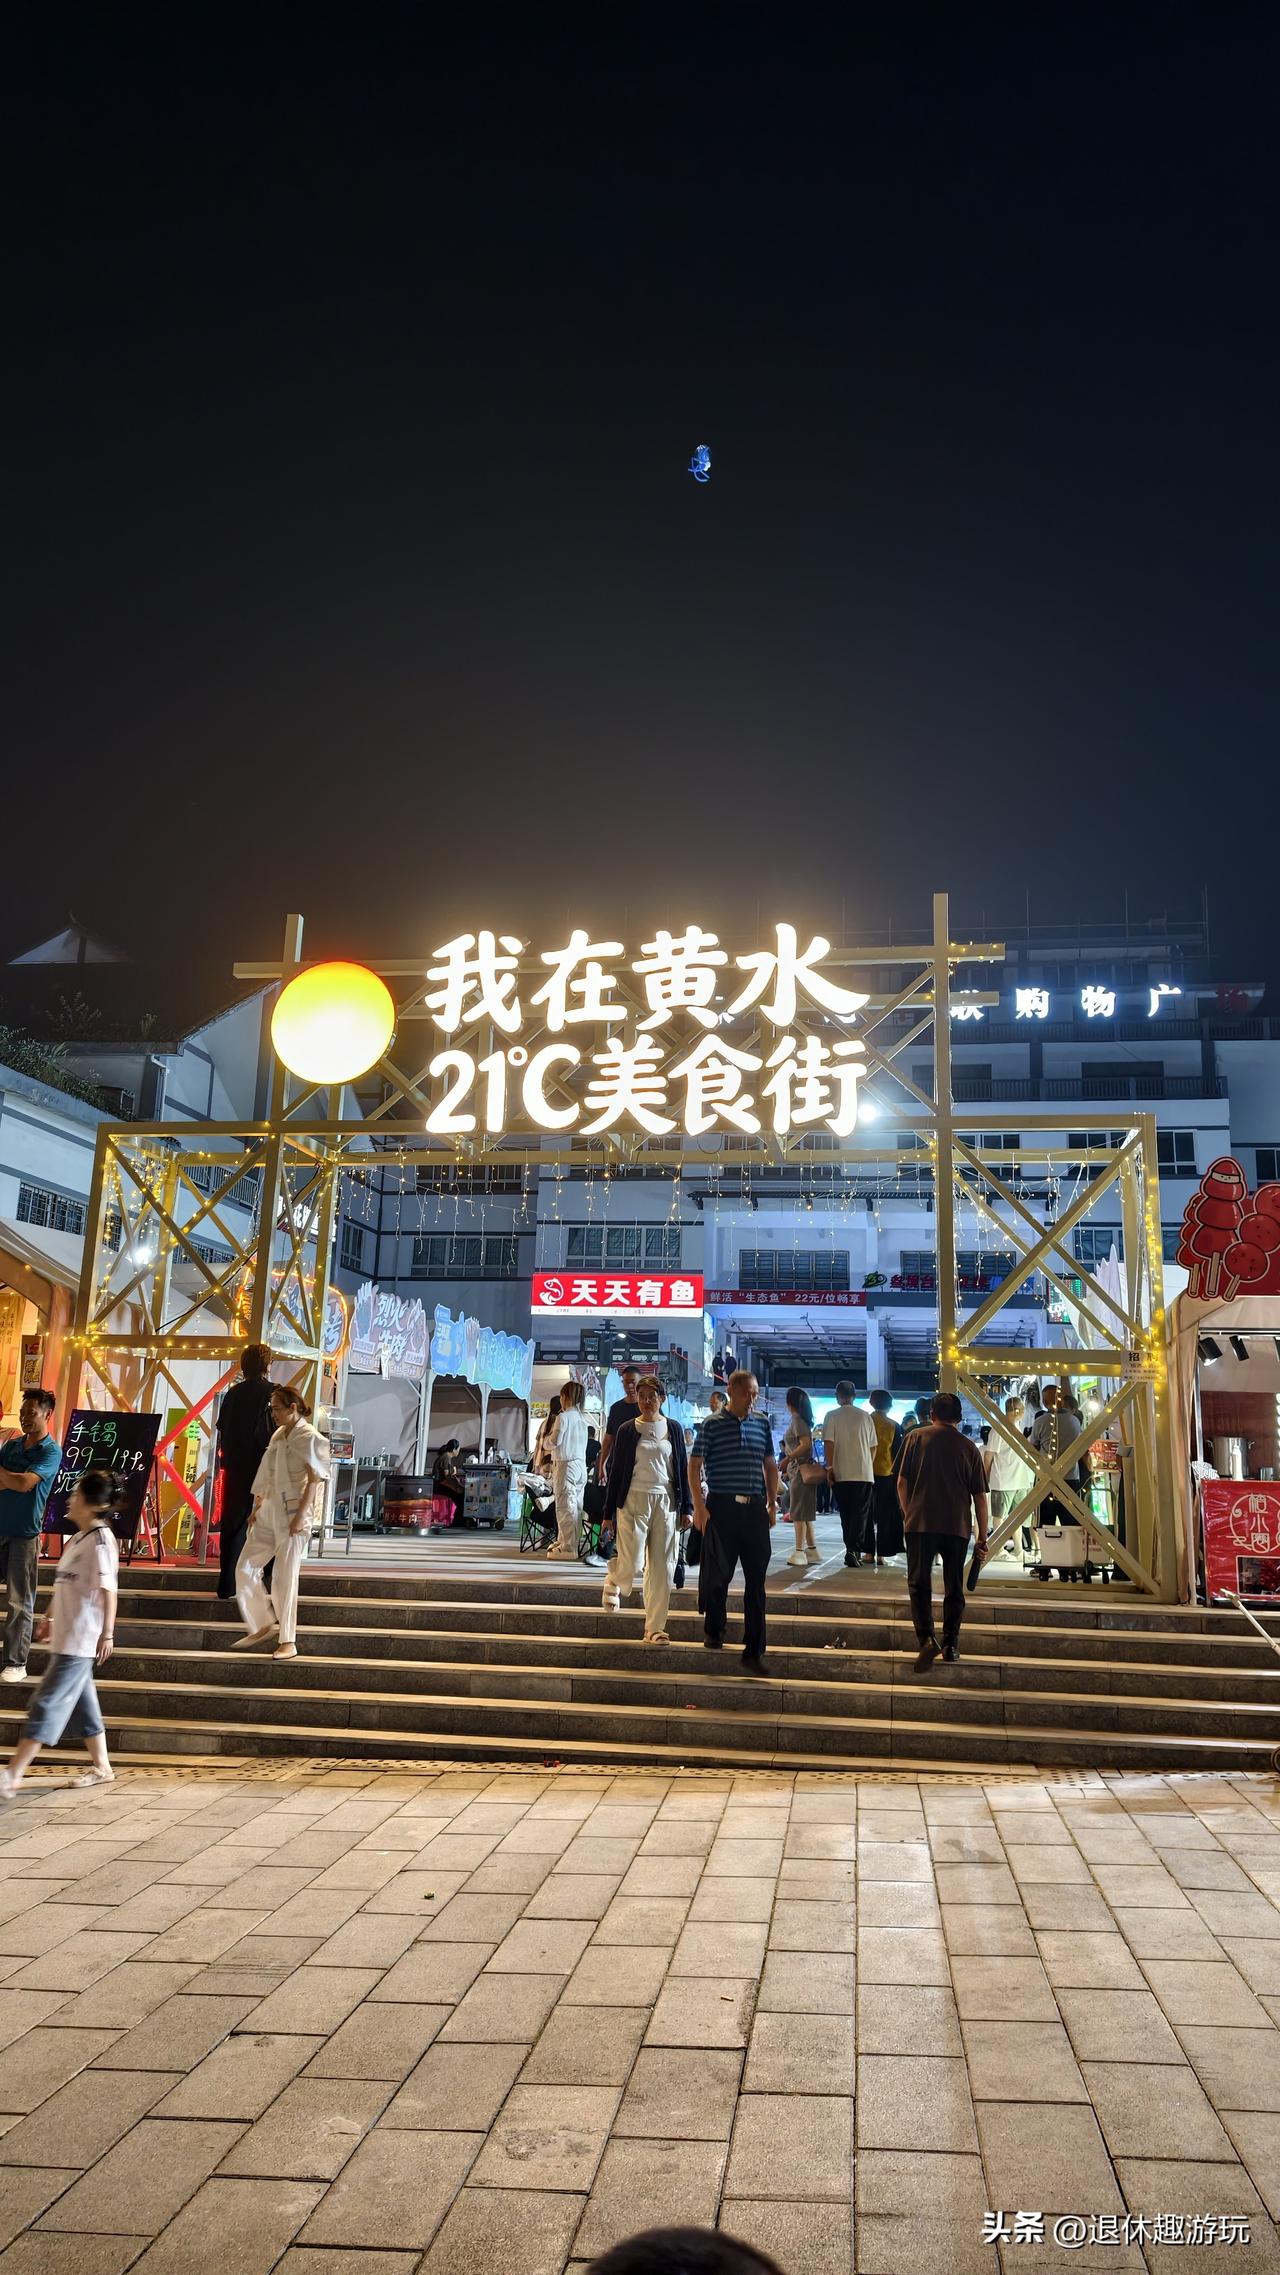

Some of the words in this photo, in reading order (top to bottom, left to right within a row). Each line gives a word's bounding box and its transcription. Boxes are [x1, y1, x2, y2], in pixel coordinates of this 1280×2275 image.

[425, 923, 870, 1033] 我在黄水
[571, 1280, 696, 1306] 天天有鱼
[70, 1420, 117, 1447] 手镯
